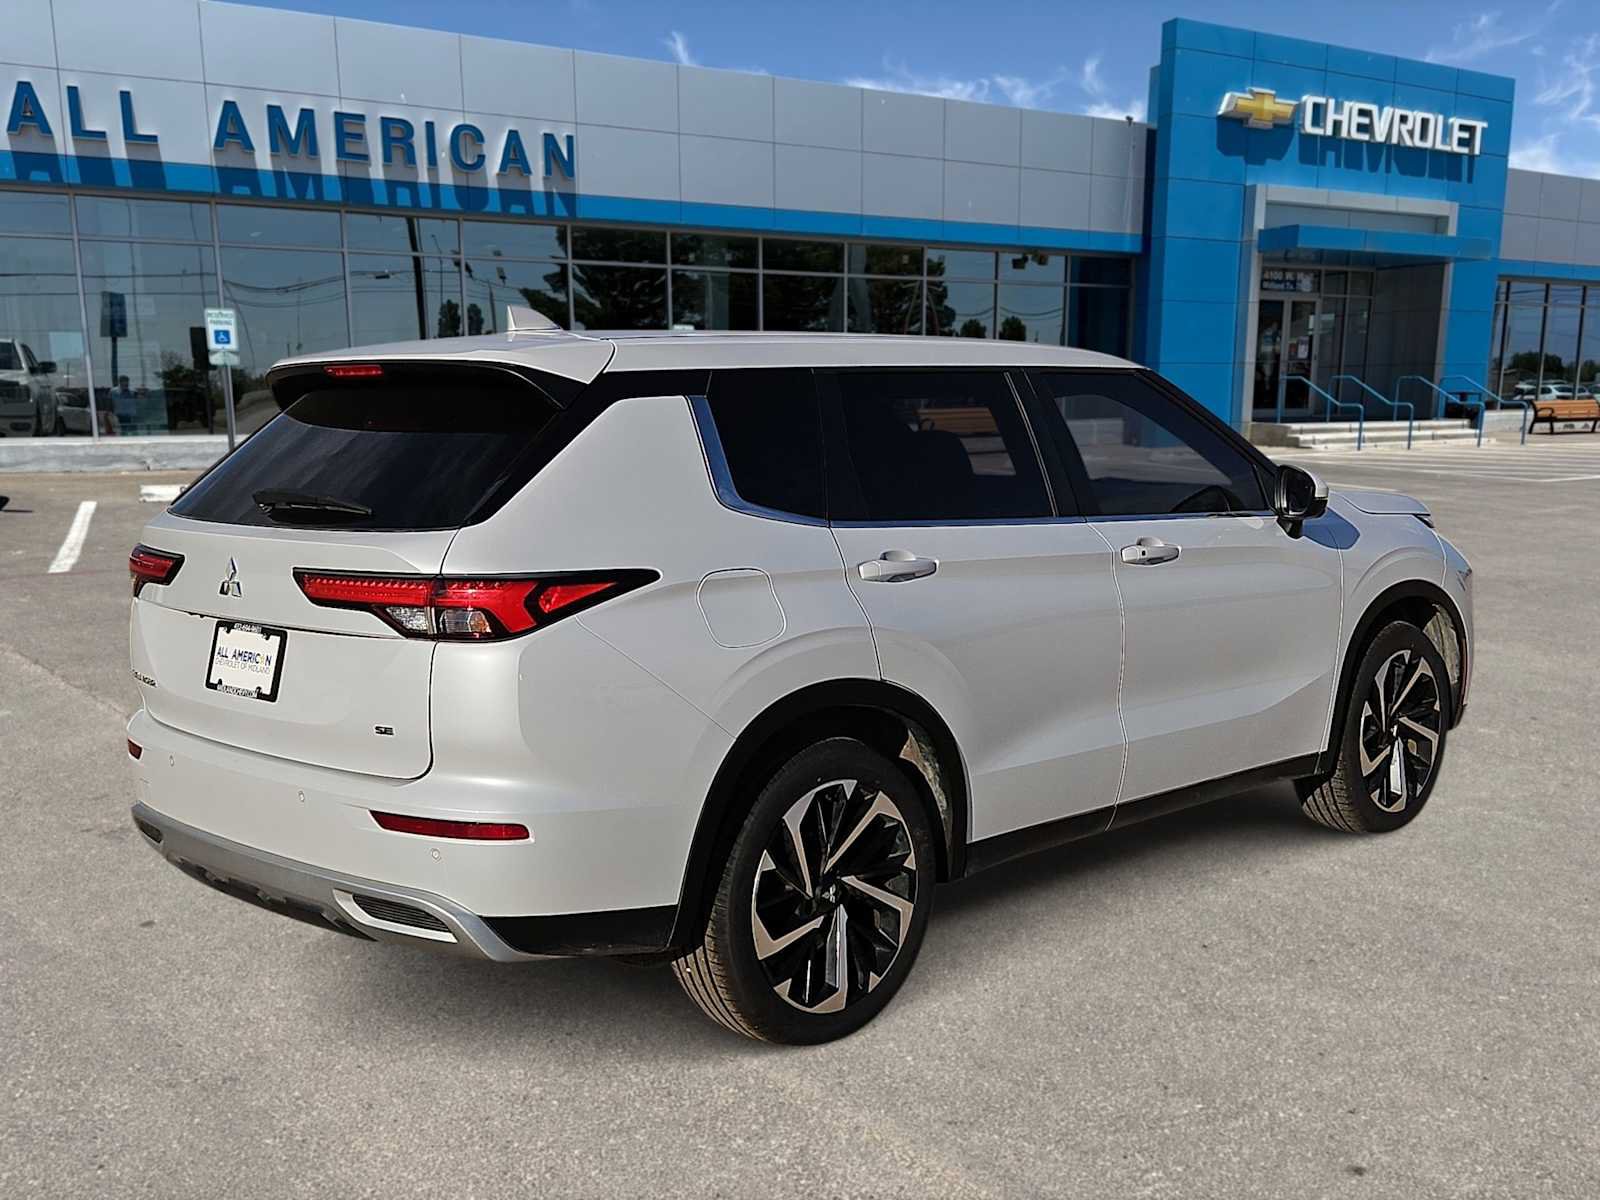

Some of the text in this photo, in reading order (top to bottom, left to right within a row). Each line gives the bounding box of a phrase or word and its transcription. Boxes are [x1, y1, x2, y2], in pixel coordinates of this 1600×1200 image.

[7, 81, 576, 179] ALL AMERICAN
[1301, 94, 1488, 156] CHEVROLET
[217, 646, 229, 659] ALL
[375, 725, 394, 736] SE
